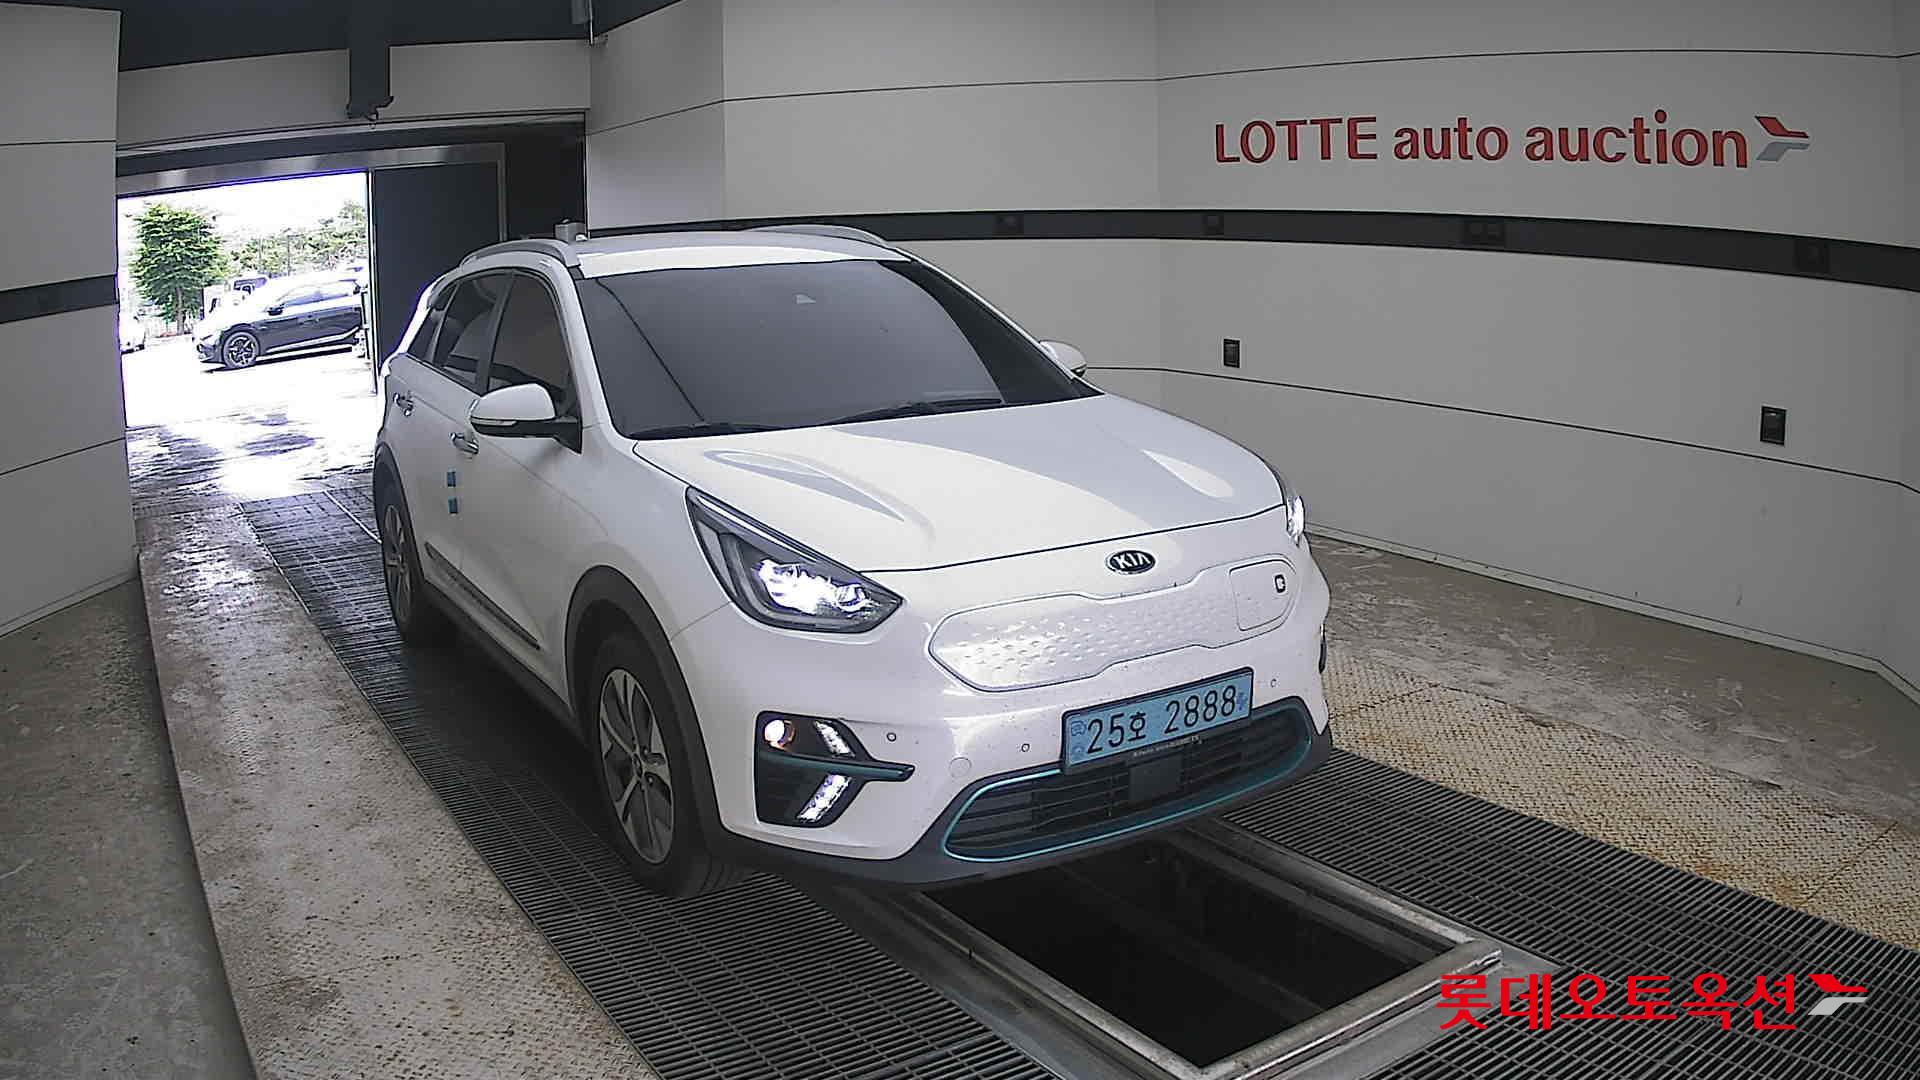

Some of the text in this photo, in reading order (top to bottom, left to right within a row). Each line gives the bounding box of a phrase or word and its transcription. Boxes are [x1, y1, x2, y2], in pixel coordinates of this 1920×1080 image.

[1215, 109, 1749, 169] LOTTE auto auction
[1112, 551, 1153, 570] KIA
[1087, 712, 1146, 754] 25호
[1164, 685, 1237, 734] 2888
